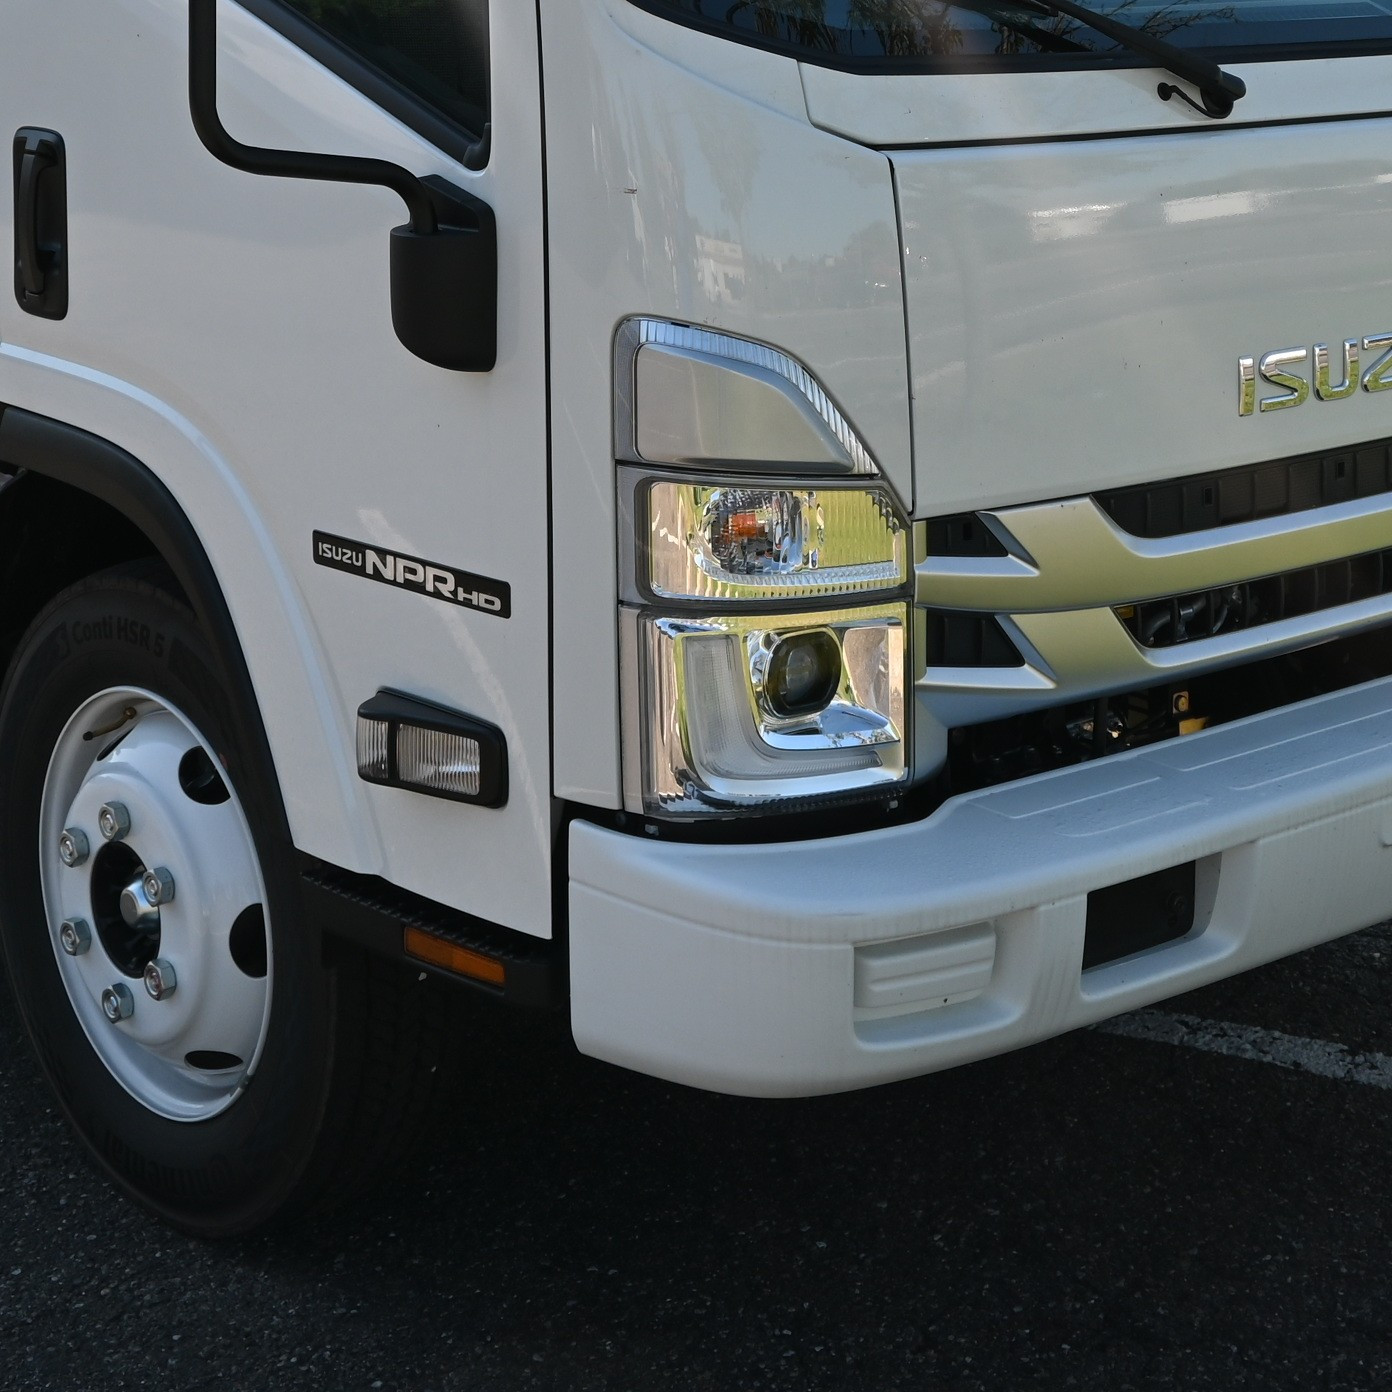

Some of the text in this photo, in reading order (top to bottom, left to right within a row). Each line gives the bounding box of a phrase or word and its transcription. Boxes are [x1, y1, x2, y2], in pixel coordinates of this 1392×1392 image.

[318, 541, 501, 612] ISUZU NPR HD
[71, 614, 165, 659] Conti HSR 5
